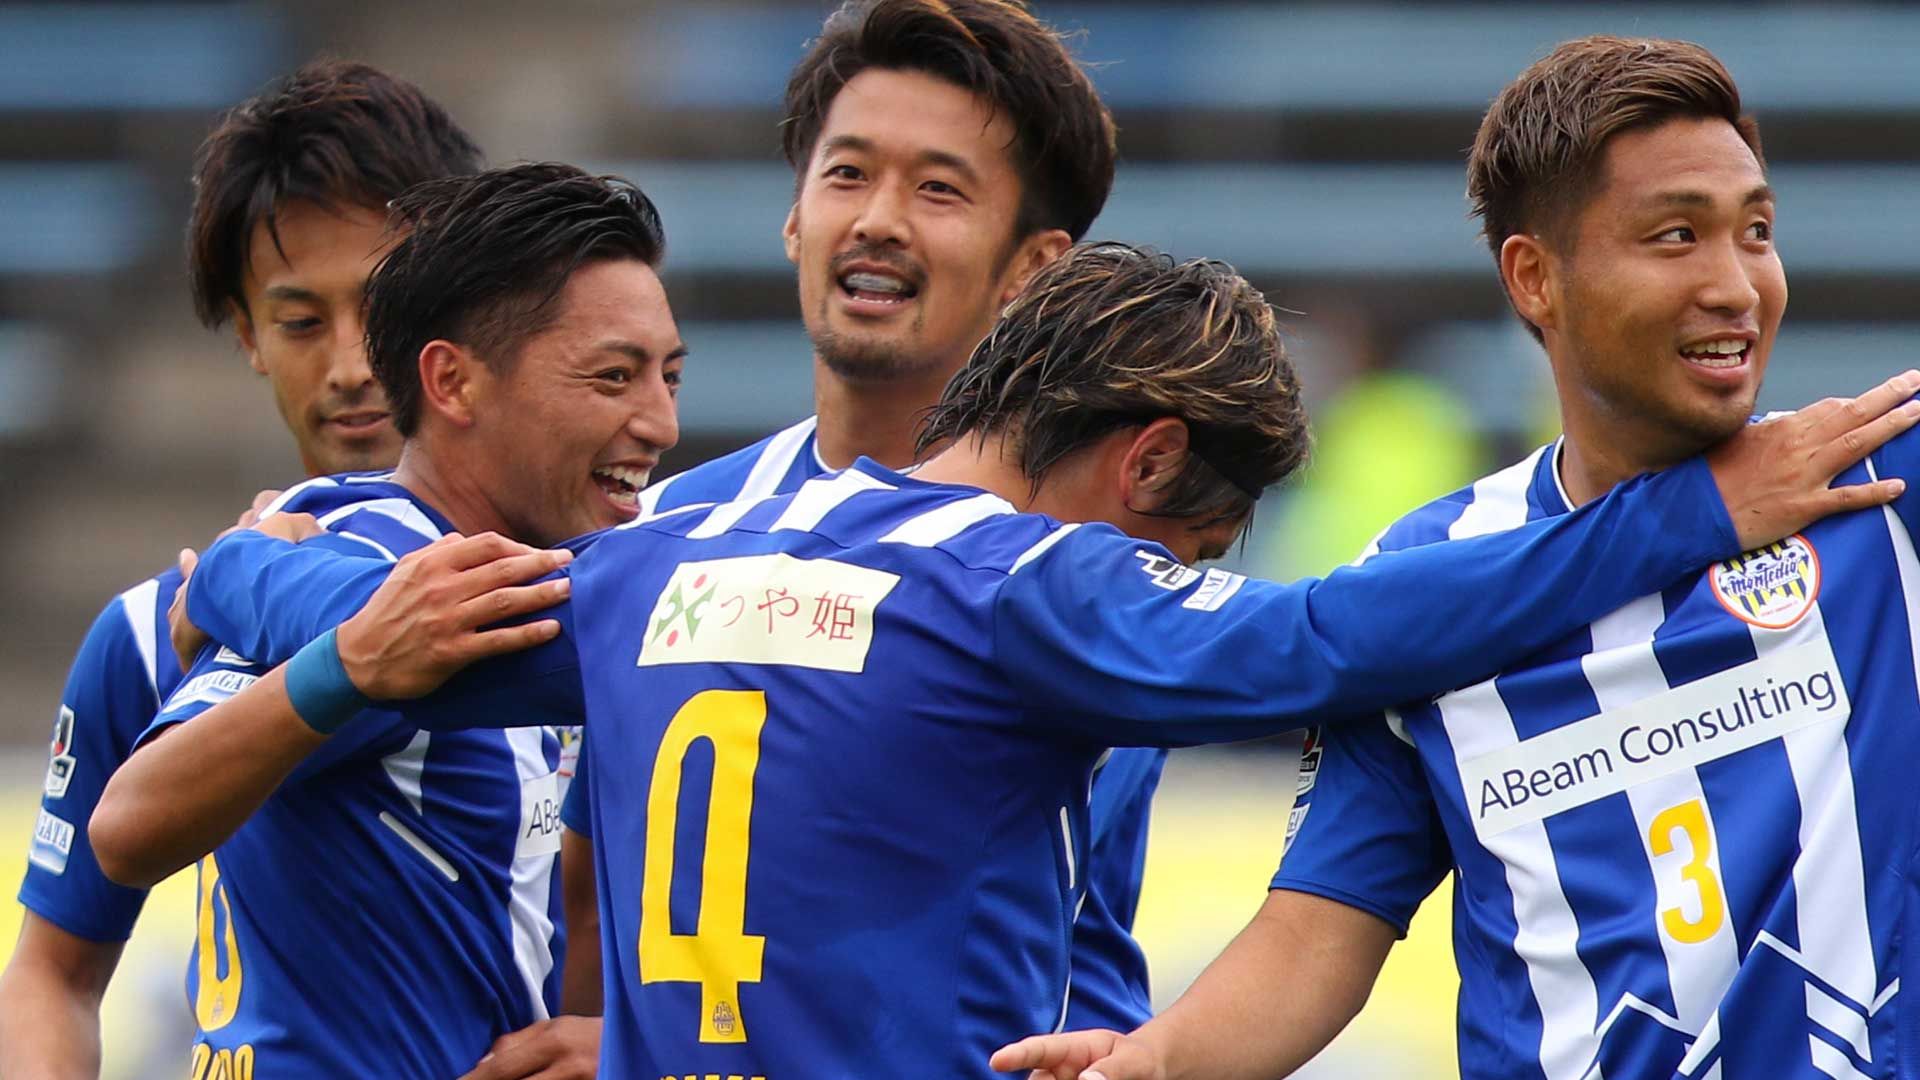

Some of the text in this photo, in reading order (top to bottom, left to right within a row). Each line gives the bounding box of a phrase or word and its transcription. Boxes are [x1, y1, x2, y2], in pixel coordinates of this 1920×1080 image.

[720, 587, 864, 641] つや姫
[1480, 670, 1837, 819] ABeam Consulting
[638, 689, 767, 1043] 4
[1649, 799, 1724, 943] 3
